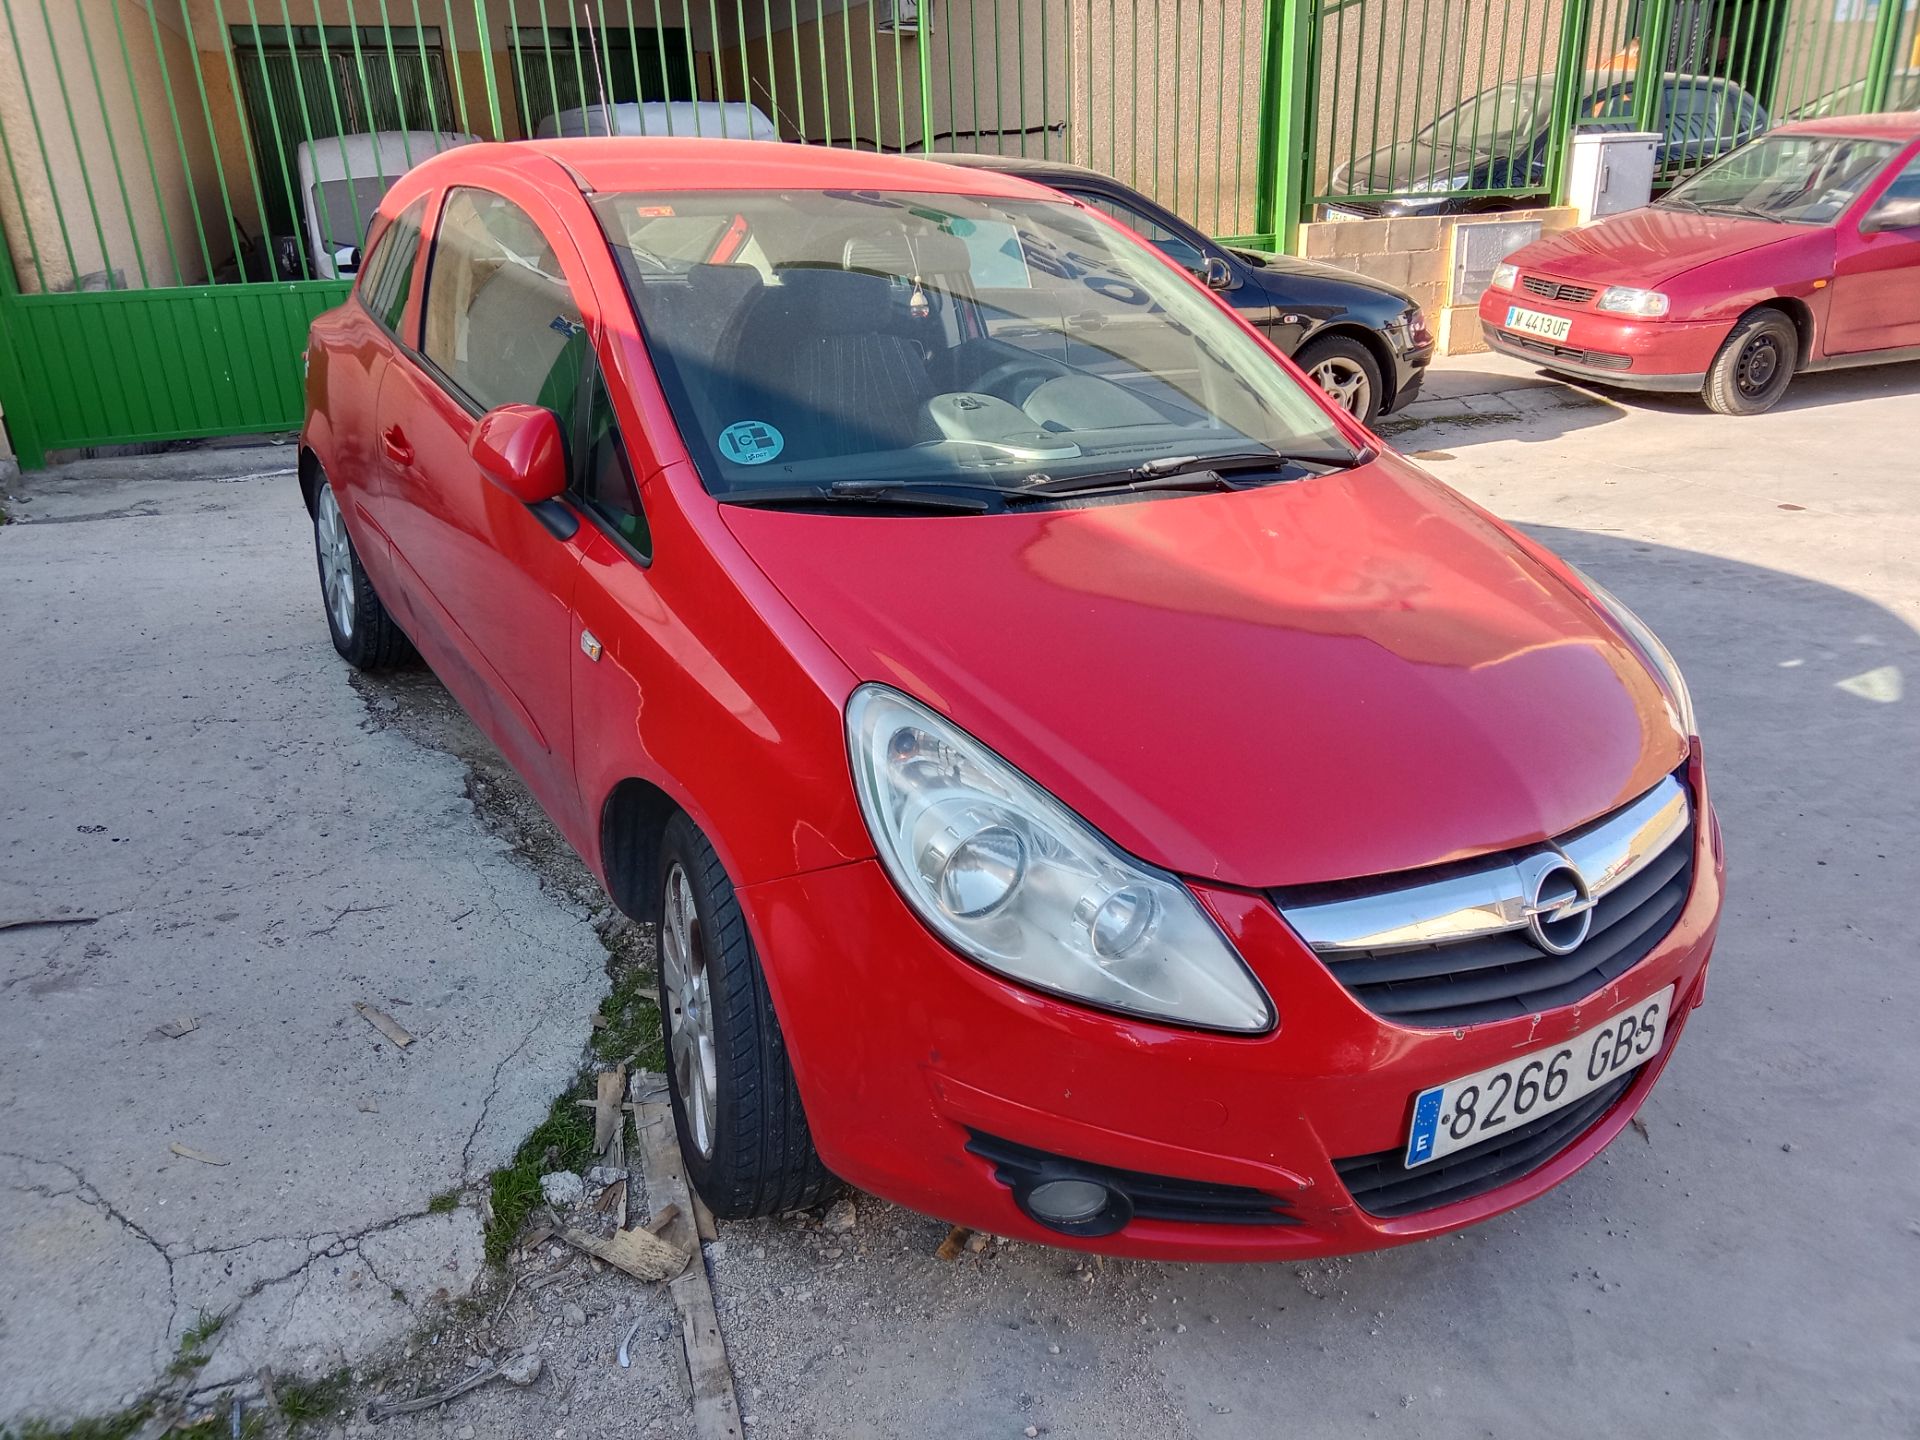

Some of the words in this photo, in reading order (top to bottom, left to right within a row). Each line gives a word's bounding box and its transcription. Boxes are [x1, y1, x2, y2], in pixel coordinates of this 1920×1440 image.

[1449, 1048, 1573, 1141] 8266
[1587, 1003, 1660, 1083] GBS
[1416, 1133, 1430, 1152] E
